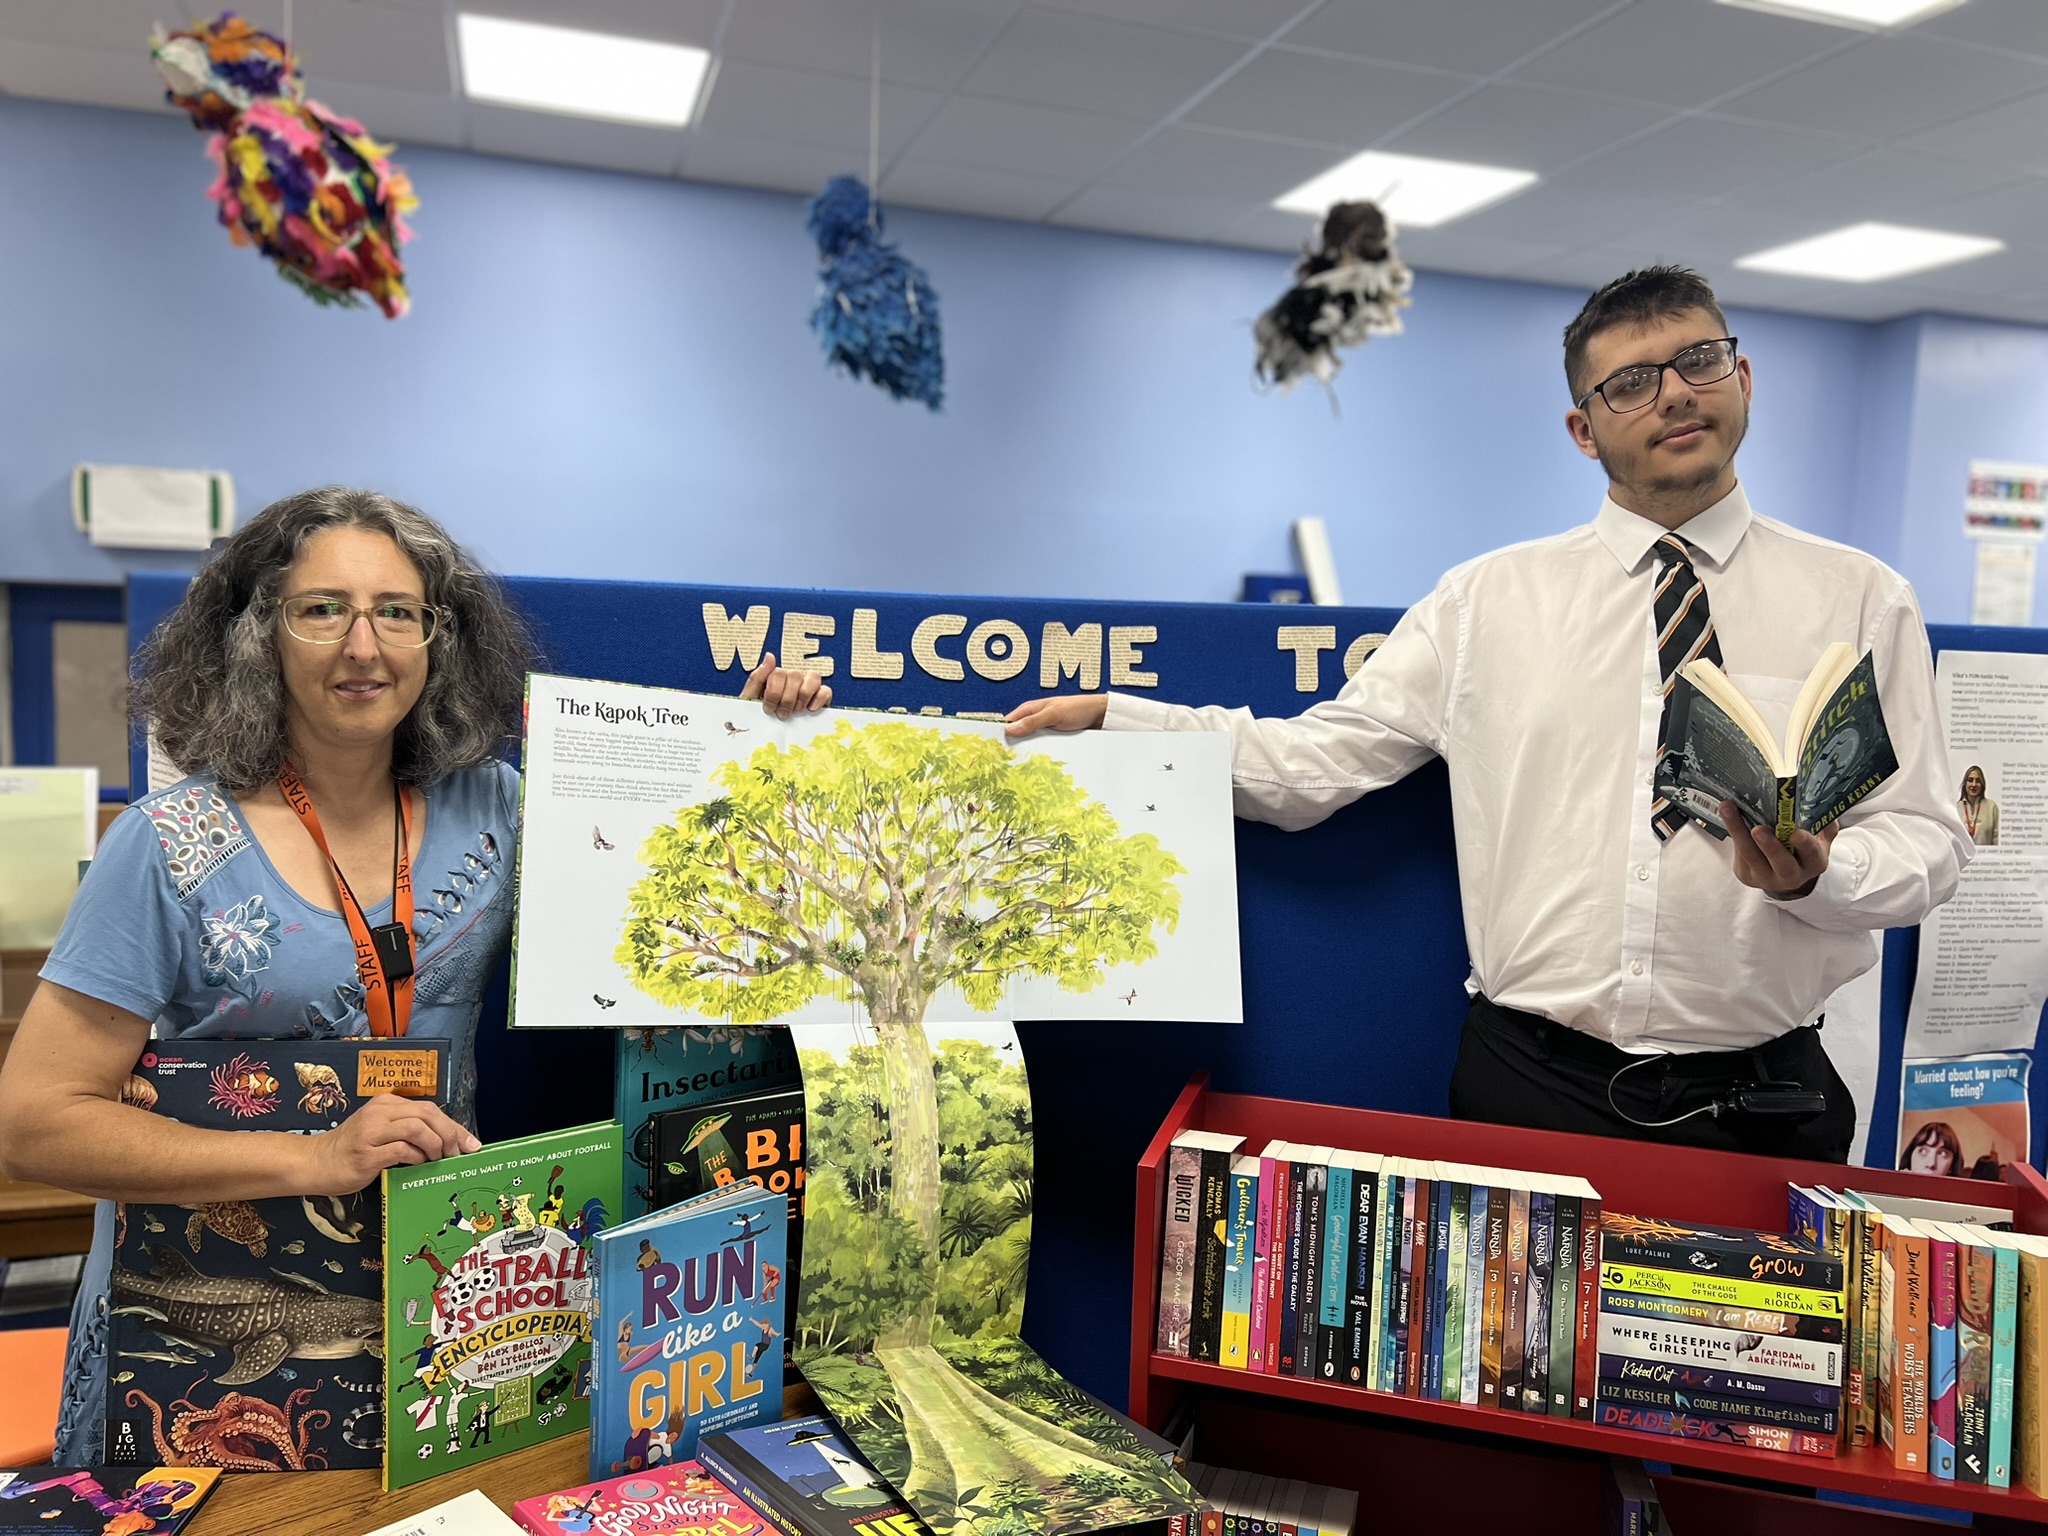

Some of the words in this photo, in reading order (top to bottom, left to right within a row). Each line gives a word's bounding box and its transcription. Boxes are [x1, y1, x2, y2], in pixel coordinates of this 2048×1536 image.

[702, 603, 1158, 691] WELCOME
[556, 697, 590, 716] The
[595, 701, 654, 727] Kapok
[652, 707, 689, 726] Tree
[1847, 773, 1882, 804] KENNY
[354, 939, 380, 991] STAFF
[363, 1055, 423, 1067] Welcome
[383, 1069, 395, 1077] to
[402, 1068, 422, 1077] the
[1914, 1068, 1946, 1084] Worried
[1948, 1068, 1973, 1081] about
[1975, 1067, 1990, 1079] how
[1993, 1065, 2018, 1082] you're
[362, 1076, 421, 1087] Museum
[1950, 1082, 1984, 1099] feeling?
[759, 1110, 777, 1120] ADAMS
[402, 1173, 457, 1190] EVERYTHING
[460, 1168, 477, 1179] YOU
[479, 1163, 504, 1174] WANT
[507, 1161, 518, 1169] TO
[520, 1155, 545, 1166] KNOW
[546, 1149, 573, 1161] ABOUT
[574, 1142, 612, 1156] FOOTBALL
[704, 1150, 728, 1172] THE
[1175, 1174, 1197, 1223] WICKED
[1206, 1176, 1215, 1218] KENEALLY
[1214, 1181, 1223, 1215] THOMAS
[1234, 1178, 1251, 1231] Gulliver's
[1332, 1175, 1341, 1210] MAGORIAN
[1339, 1177, 1347, 1210] MICHELLE
[1359, 1183, 1370, 1214] DEAR
[1310, 1195, 1319, 1222] TOM'S
[1307, 1223, 1318, 1266] MIDNIGHT
[1358, 1216, 1368, 1244] EVAN
[1489, 1217, 1502, 1260] NARNIA
[1511, 1220, 1523, 1262] NARNIA
[1535, 1223, 1548, 1266] NARNIA
[1859, 1214, 1876, 1256] David
[455, 1250, 489, 1273] THE
[1175, 1240, 1185, 1282] GREGORY
[1234, 1231, 1247, 1266] Travels
[1560, 1225, 1573, 1269] NARNIA
[1582, 1228, 1596, 1271] NARNIA
[1644, 1249, 1671, 1258] PALMER
[1906, 1244, 1920, 1276] David
[1276, 1271, 1281, 1281] ON
[1292, 1261, 1298, 1270] TO
[1356, 1246, 1367, 1290] HANSEN
[1491, 1274, 1497, 1282] 3
[1513, 1276, 1519, 1284] 4
[1636, 1271, 1665, 1281] PERCY
[642, 1240, 757, 1330] RUN
[1290, 1284, 1298, 1312] GALAXY
[1306, 1268, 1315, 1304] GARDEN
[1329, 1284, 1338, 1302] Tom
[1584, 1286, 1590, 1294] 7
[1628, 1279, 1671, 1291] JACKSON
[1691, 1288, 1701, 1296] OF
[1703, 1290, 1716, 1298] THE
[1717, 1292, 1737, 1301] GODS
[1693, 1281, 1705, 1291] THE
[1707, 1283, 1738, 1293] CHALICE
[1776, 1291, 1801, 1301] RICK
[1860, 1258, 1875, 1311] Walliams
[1907, 1277, 1919, 1319] Walliams
[2007, 1270, 2016, 1308] CLARE
[457, 1281, 569, 1333] SCHOOL
[1172, 1283, 1181, 1322] MAGUIRE
[1608, 1296, 1635, 1308] ROSS
[1638, 1301, 1709, 1318] MONTGOMERY
[1764, 1298, 1813, 1311] RIORDAN
[662, 1323, 717, 1359] like
[722, 1311, 743, 1333] a
[1724, 1313, 1741, 1322] am
[1744, 1310, 1788, 1333] REBEL
[439, 1315, 582, 1370] ENCYCLOPEDIA
[1352, 1327, 1361, 1359] EMMICH
[1612, 1327, 1657, 1341] WHERE
[1664, 1334, 1731, 1352] SLEEPING
[1649, 1343, 1687, 1355] GIRLS
[1694, 1348, 1715, 1359] LIE
[1761, 1349, 1802, 1360] FARIDAH
[1621, 1360, 1655, 1378] Kicked
[1654, 1365, 1678, 1384] Out
[1904, 1343, 1915, 1378] WORST
[1914, 1359, 1924, 1377] THE
[629, 1341, 764, 1432] GIRL
[1727, 1379, 1735, 1387] A.
[1736, 1380, 1745, 1389] M.
[1746, 1381, 1766, 1392] Dassu
[1850, 1372, 1862, 1405] PETS
[1914, 1380, 1924, 1420] WORLDS
[708, 1406, 747, 1424] EXTRAORDINARY
[748, 1402, 758, 1410] AND
[725, 1410, 759, 1426] SPORTSWOMEN
[1602, 1385, 1620, 1398] LIZ
[1624, 1388, 1671, 1405] KESSLER
[1693, 1399, 1718, 1410] CODE
[1721, 1402, 1751, 1415] NAME
[1754, 1406, 1820, 1424] Kingfisher
[1902, 1380, 1915, 1435] TEACHERS
[1963, 1394, 1973, 1445] MCLACHLAN
[1748, 1425, 1789, 1439] SIMON
[1975, 1407, 1985, 1436] JENNY
[1755, 1438, 1782, 1450] FOX
[636, 1514, 714, 1532] STORIES
[652, 1495, 740, 1523] NIGHT
[742, 1486, 750, 1498] AN
[750, 1493, 780, 1522] ILLUSTRATED
[780, 1517, 802, 1536] HISTORY
